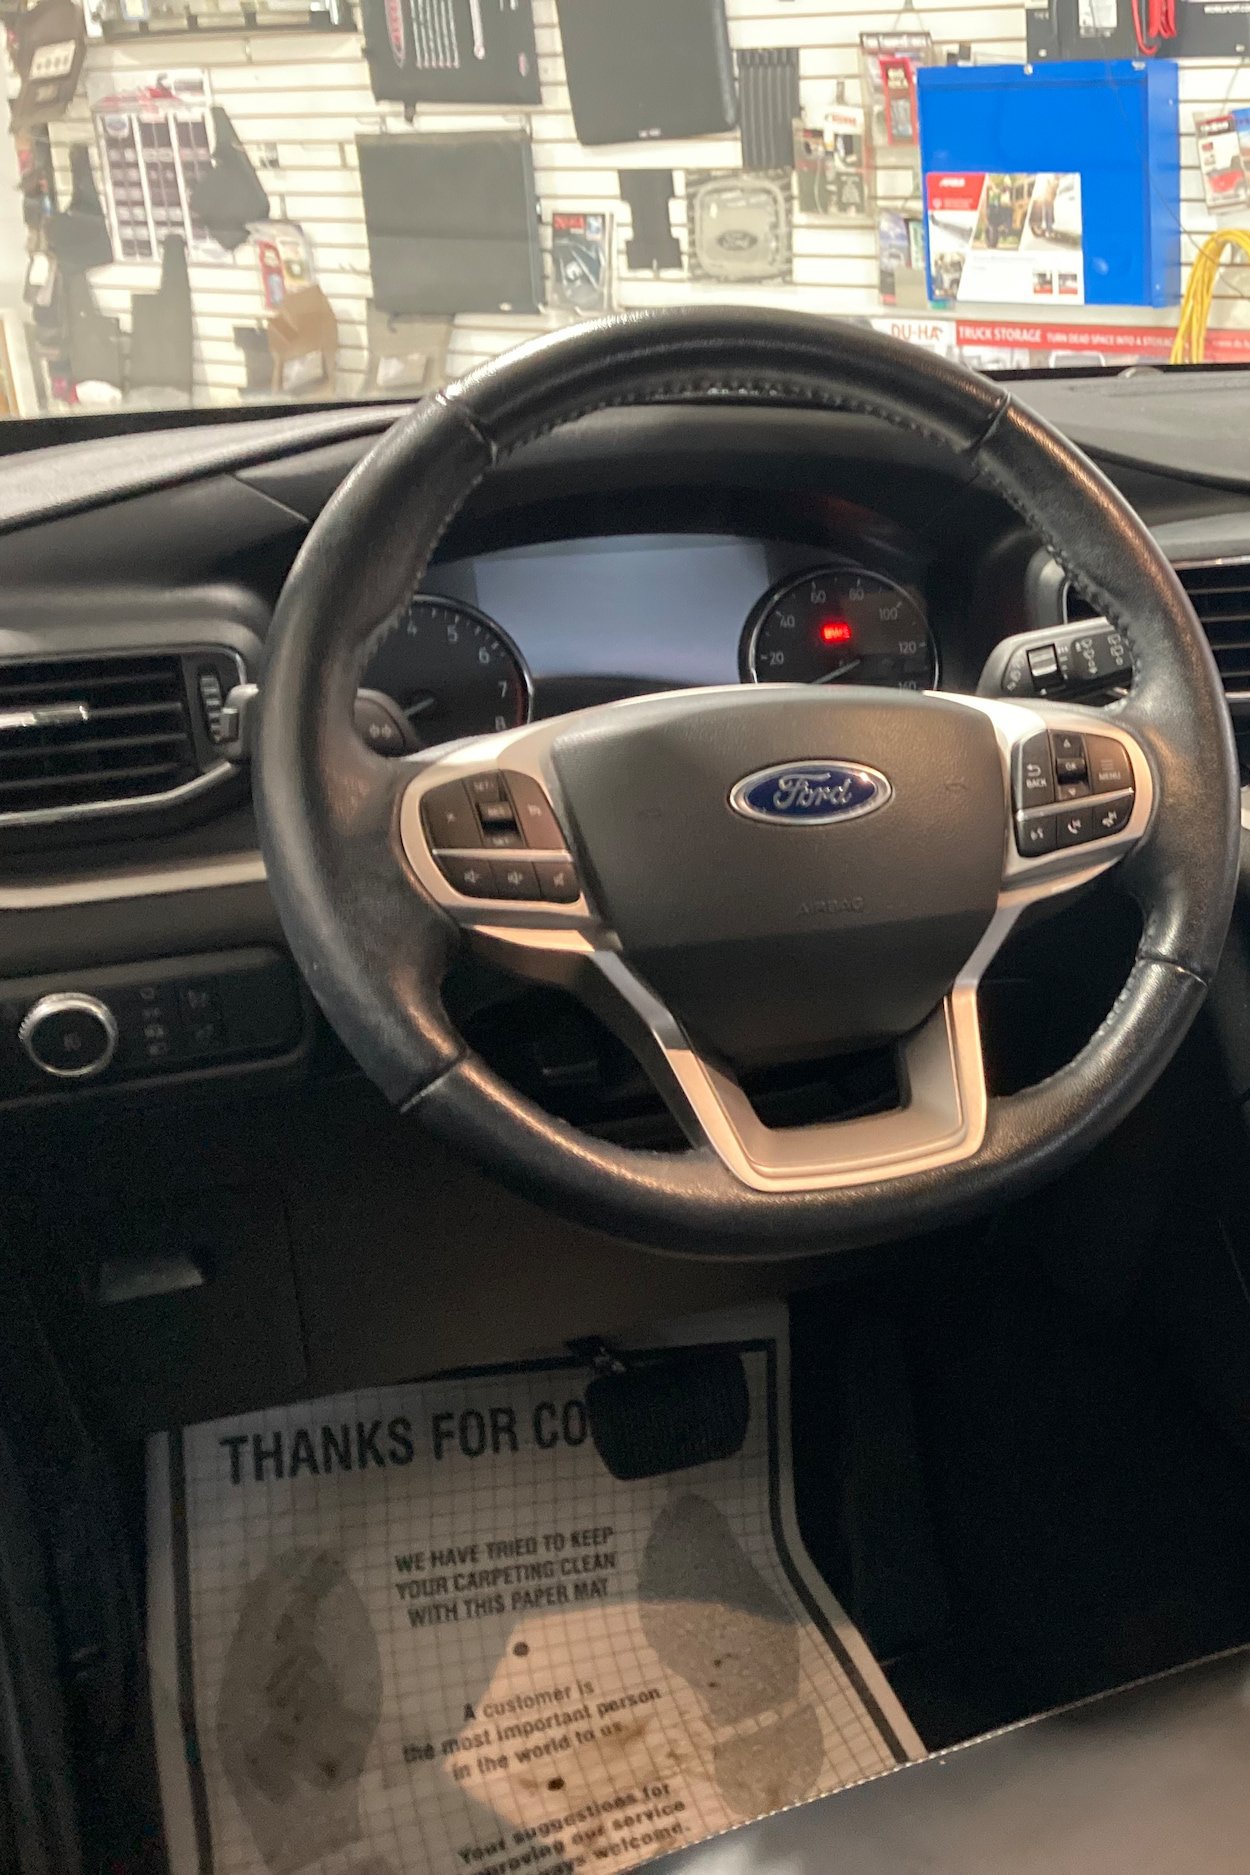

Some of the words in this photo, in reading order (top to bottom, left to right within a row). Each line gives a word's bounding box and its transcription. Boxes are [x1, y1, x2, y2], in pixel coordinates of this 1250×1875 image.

[890, 322, 942, 343] DU-HA
[958, 325, 993, 342] TRUCK
[994, 326, 1041, 344] STORAGE
[1091, 333, 1114, 346] SPACE
[1115, 335, 1135, 347] INTO
[810, 589, 827, 604] 60
[849, 588, 865, 601] 80
[780, 614, 795, 628] 40
[879, 607, 898, 621] 100
[407, 620, 418, 637] 4
[447, 624, 458, 643] 5
[478, 646, 490, 664] 6
[899, 641, 917, 655] 120
[769, 652, 785, 665] 20
[498, 680, 507, 698] 7
[1026, 778, 1047, 789] BACK
[1098, 771, 1121, 781] MENU
[773, 772, 853, 809] Ford
[219, 1415, 414, 1485] THANKS
[432, 1406, 519, 1461] FOR
[532, 1400, 590, 1449] CO
[394, 1552, 425, 1573] WE
[431, 1545, 479, 1568] HAVE
[485, 1536, 537, 1560] TRIED
[543, 1532, 565, 1553] TO
[570, 1526, 614, 1549] KEEP
[395, 1577, 448, 1600] YOUR
[453, 1561, 554, 1592] CARPETING
[561, 1551, 617, 1576] CLEAN
[407, 1604, 458, 1628] WITH
[463, 1594, 505, 1618] THIS
[511, 1584, 569, 1610] PAPER
[573, 1578, 609, 1600] MAT
[463, 1702, 477, 1721] A
[483, 1684, 571, 1719] customer
[578, 1678, 595, 1696] is
[402, 1743, 435, 1764] the
[441, 1729, 492, 1755] most
[497, 1703, 593, 1742] important
[596, 1687, 662, 1716] person
[452, 1762, 472, 1781] in
[477, 1749, 510, 1775] the
[515, 1734, 571, 1764] world
[575, 1728, 596, 1745] to
[602, 1720, 624, 1737] us
[458, 1838, 505, 1864] Your
[512, 1792, 638, 1844] suggestions
[642, 1781, 672, 1802] for
[572, 1823, 605, 1846] our
[612, 1799, 686, 1831] service
